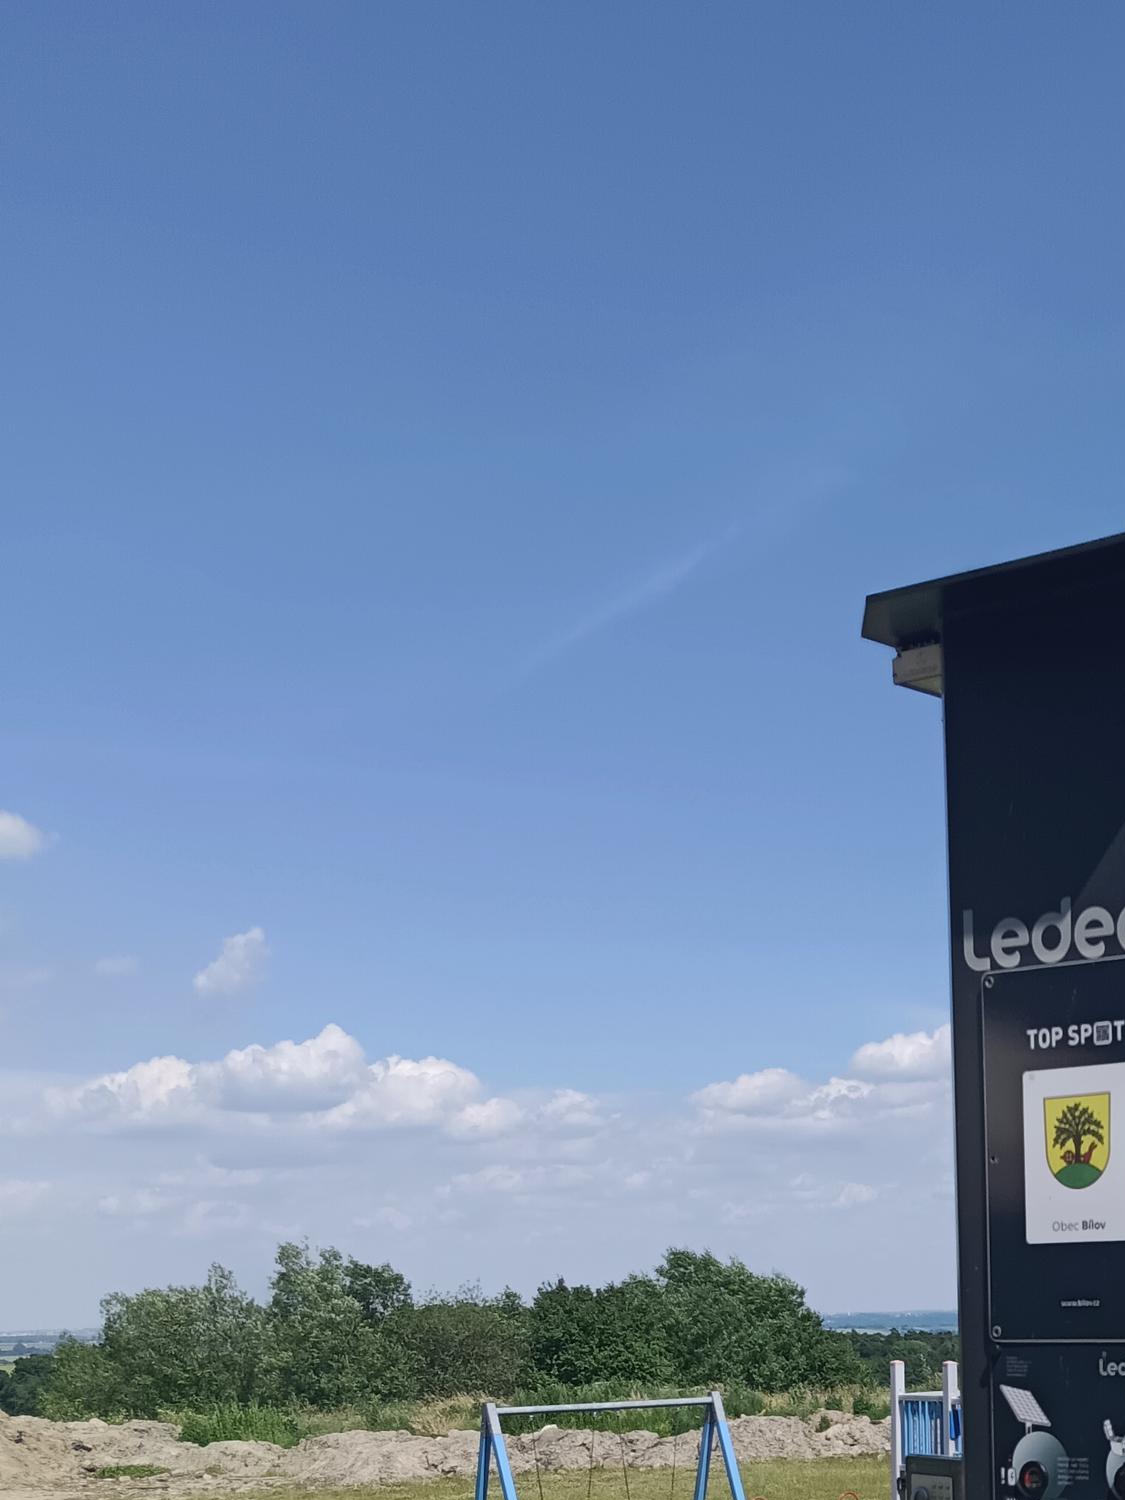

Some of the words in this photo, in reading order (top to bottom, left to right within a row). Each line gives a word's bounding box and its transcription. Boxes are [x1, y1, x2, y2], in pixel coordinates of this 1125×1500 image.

[1026, 1027, 1063, 1050] TOP
[1052, 1219, 1079, 1232] Obec
[1081, 1218, 1106, 1232] Bílov
